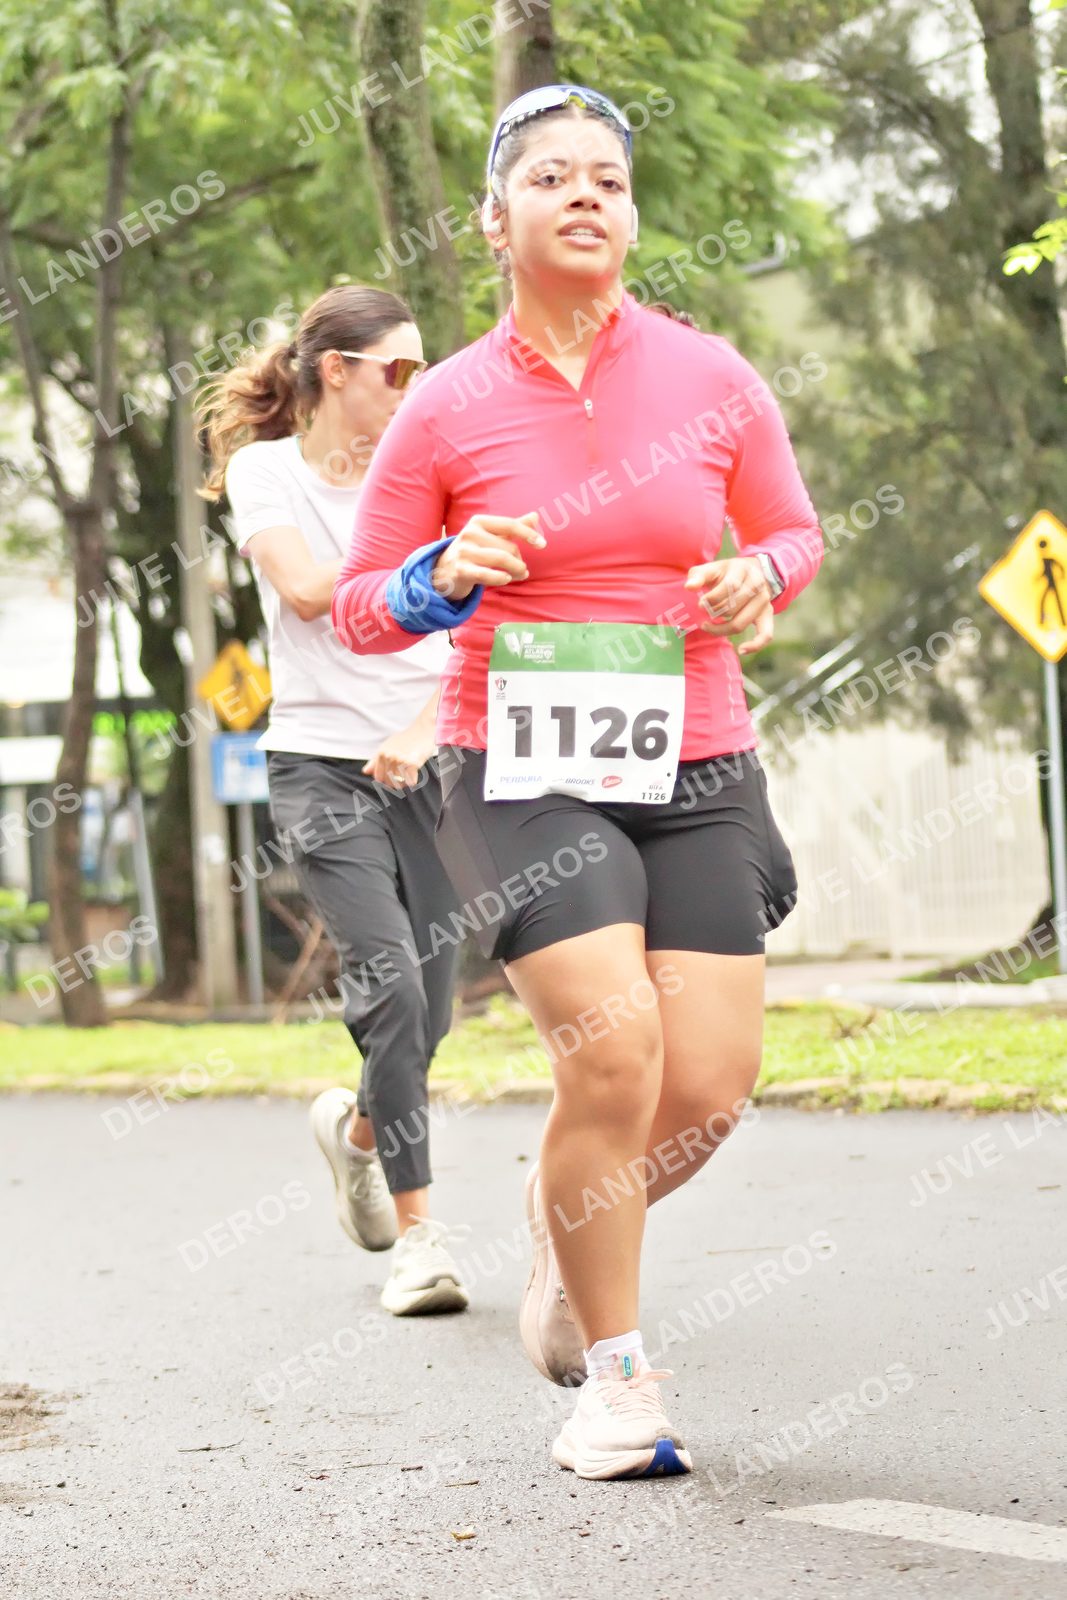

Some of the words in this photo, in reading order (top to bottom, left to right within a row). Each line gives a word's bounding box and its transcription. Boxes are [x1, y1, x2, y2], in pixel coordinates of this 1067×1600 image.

[507, 705, 670, 760] 1126
[500, 775, 542, 784] PERDURA
[565, 777, 595, 785] BROOKS
[641, 792, 667, 801] 1126
